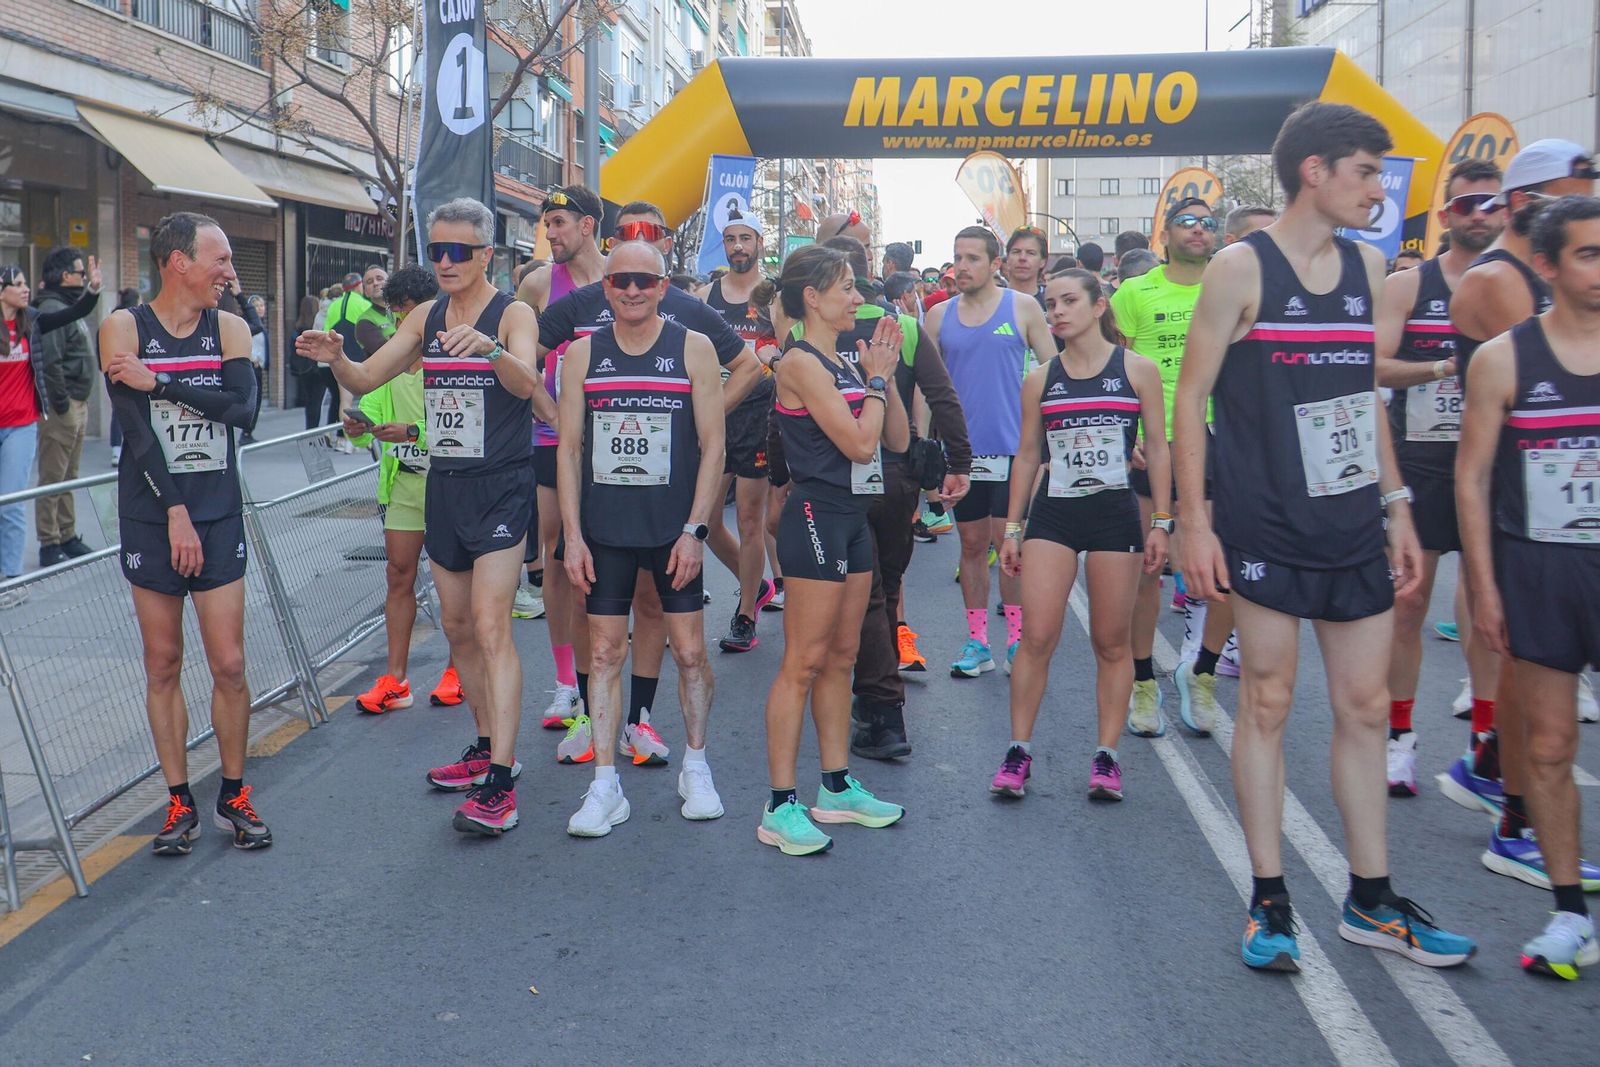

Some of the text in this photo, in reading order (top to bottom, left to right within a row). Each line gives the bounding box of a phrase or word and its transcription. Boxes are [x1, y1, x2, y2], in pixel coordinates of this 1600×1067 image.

[453, 46, 475, 119] 1
[843, 71, 1198, 127] MARCELINO
[882, 129, 1153, 151] www.mpmarcelino.es
[720, 171, 750, 188] CAJÓN
[175, 401, 204, 417] KIPRUN
[436, 412, 464, 429] 702
[165, 422, 214, 442] 1771
[1330, 427, 1358, 454] 378
[611, 437, 649, 455] 888
[1063, 450, 1109, 469] 1439
[1560, 482, 1600, 504] 11
